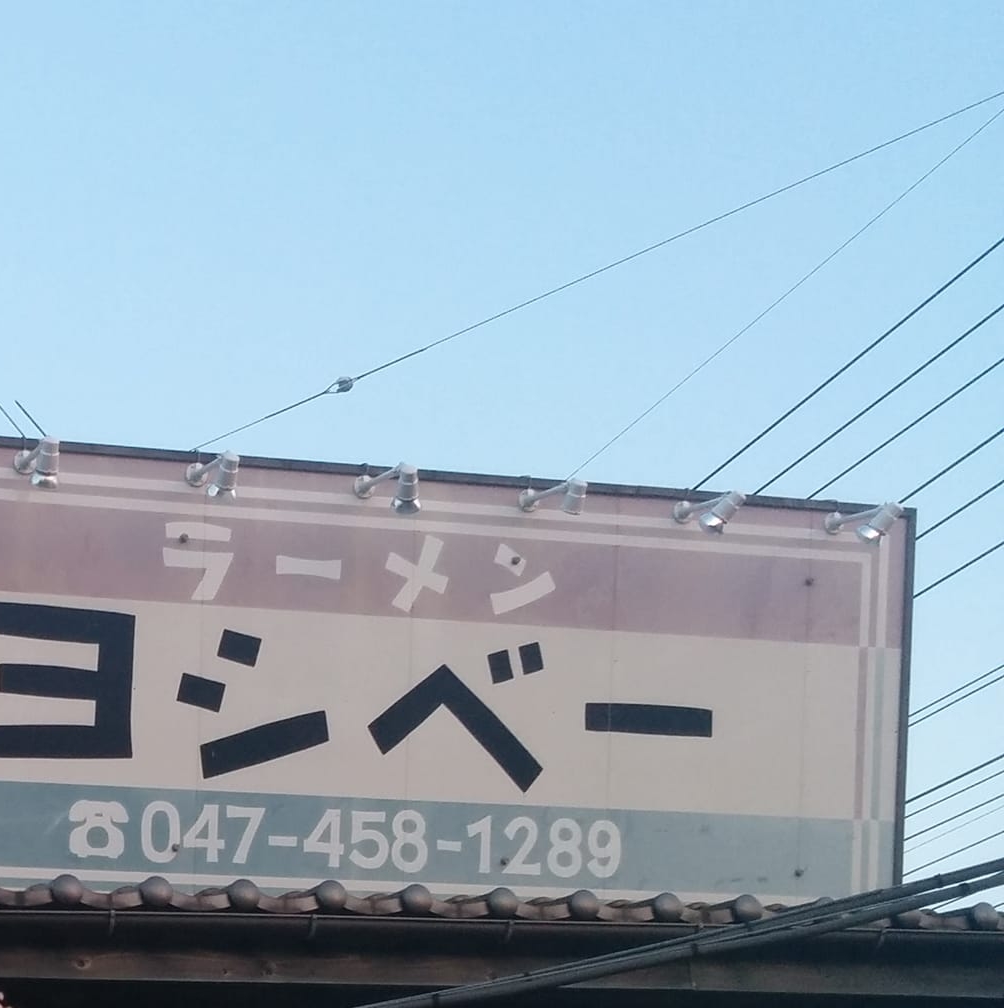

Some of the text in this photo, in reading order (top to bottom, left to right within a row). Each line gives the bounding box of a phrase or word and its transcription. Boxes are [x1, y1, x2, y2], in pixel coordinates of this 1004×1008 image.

[162, 522, 556, 615] ラーメン
[141, 801, 622, 879] 047-458-1289
